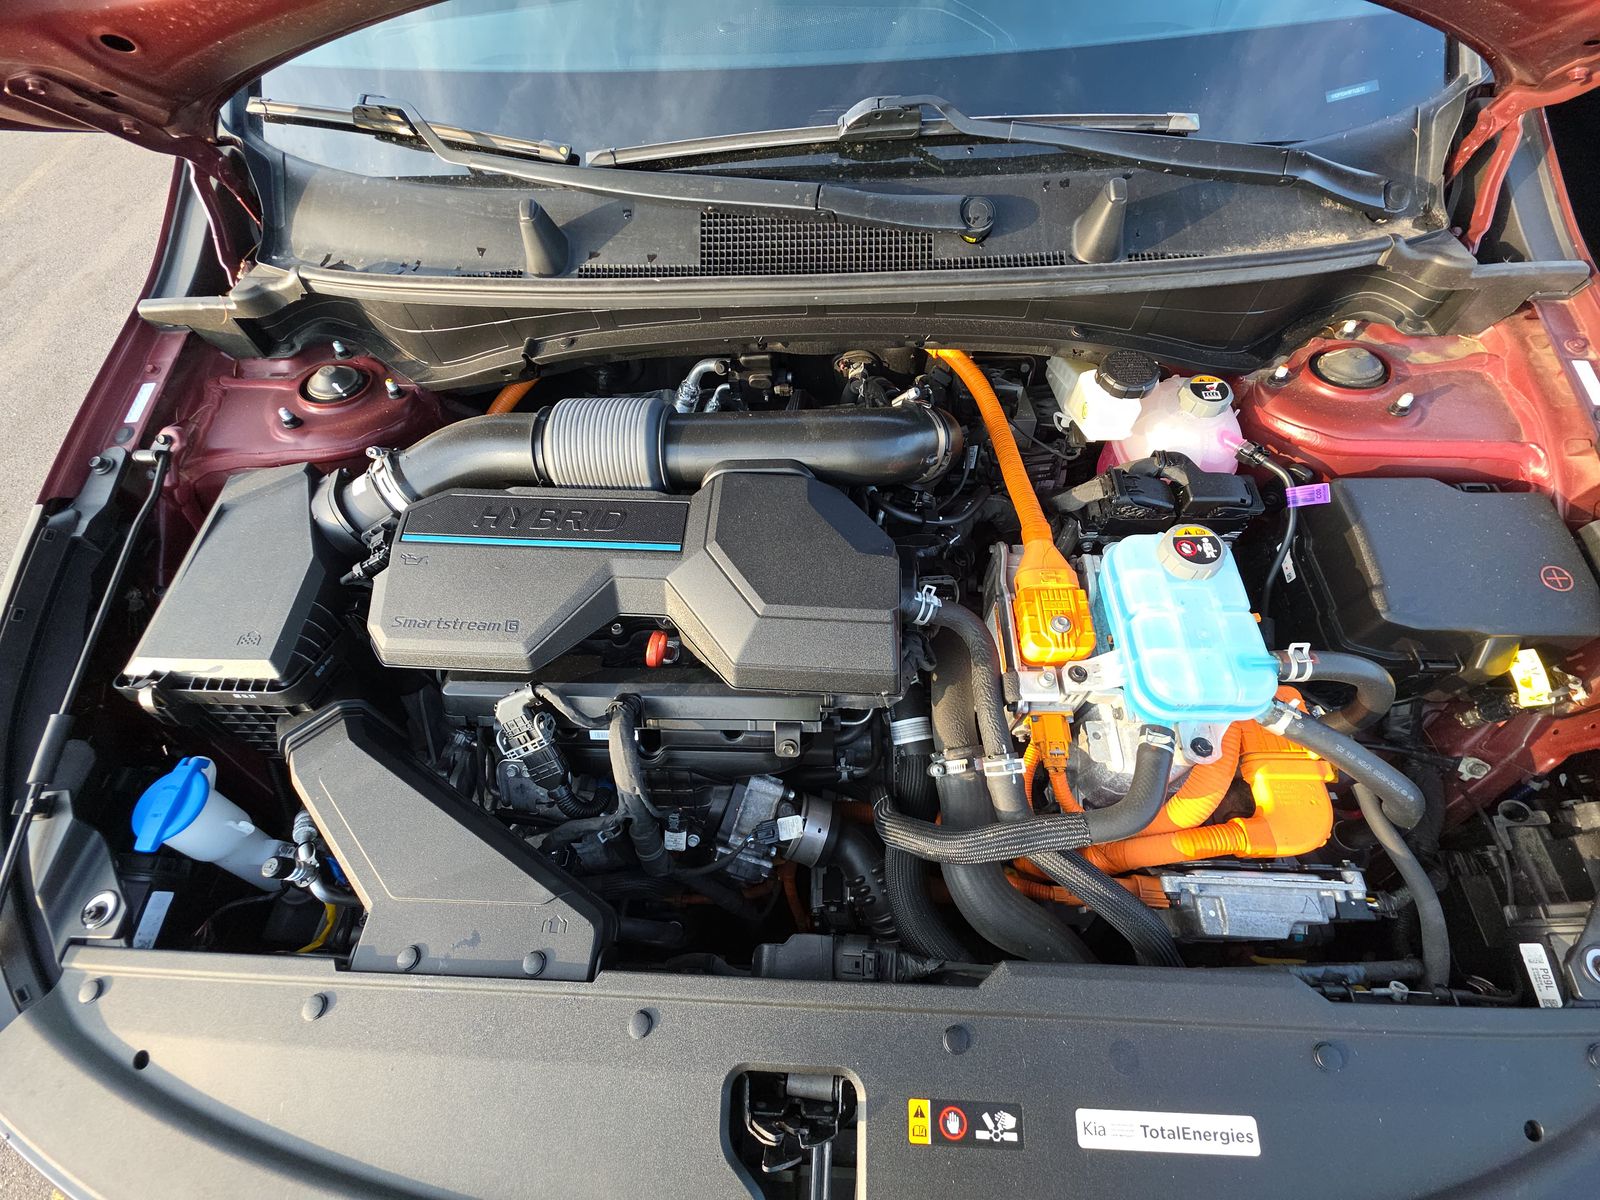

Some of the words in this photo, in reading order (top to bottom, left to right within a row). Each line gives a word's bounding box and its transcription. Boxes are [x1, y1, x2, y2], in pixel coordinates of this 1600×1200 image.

[472, 505, 628, 532] HYBRID
[391, 615, 502, 631] Smartstream
[1540, 967, 1555, 990] P09L
[1083, 1120, 1107, 1137] Kia
[1140, 1124, 1254, 1145] TotalEnergies
